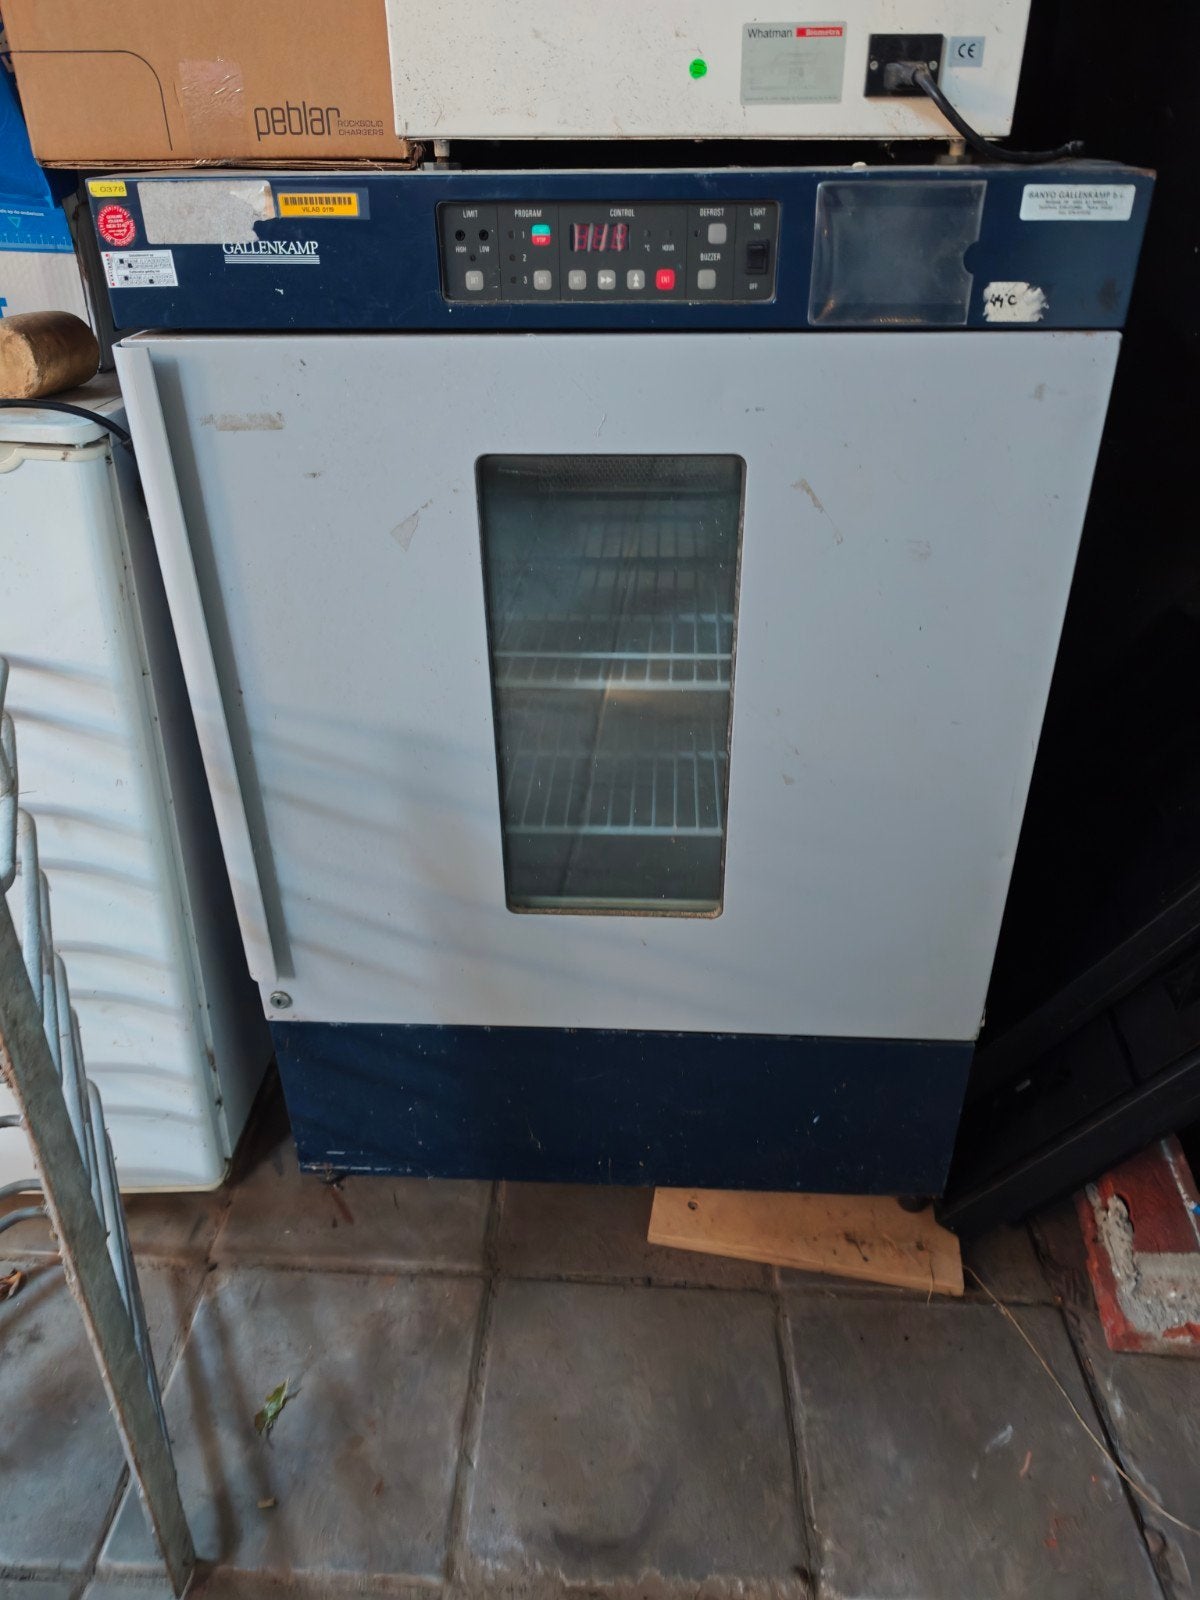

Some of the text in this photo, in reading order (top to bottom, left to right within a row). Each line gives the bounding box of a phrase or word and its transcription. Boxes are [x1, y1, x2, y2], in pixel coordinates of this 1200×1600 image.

[747, 28, 793, 39] Whatman
[254, 100, 340, 141] peblar
[337, 120, 383, 128] ROCKSOLID
[462, 209, 479, 218] LIMIT
[514, 209, 542, 217] PROGRAM
[609, 208, 635, 217] CONTROL
[699, 207, 725, 216] DEFROST
[749, 207, 767, 216] LIGHT
[753, 222, 761, 230] ON
[222, 240, 319, 255] GALLENKAMP
[522, 253, 527, 262] 2
[700, 252, 721, 261] BUZZER
[523, 276, 528, 285] 3
